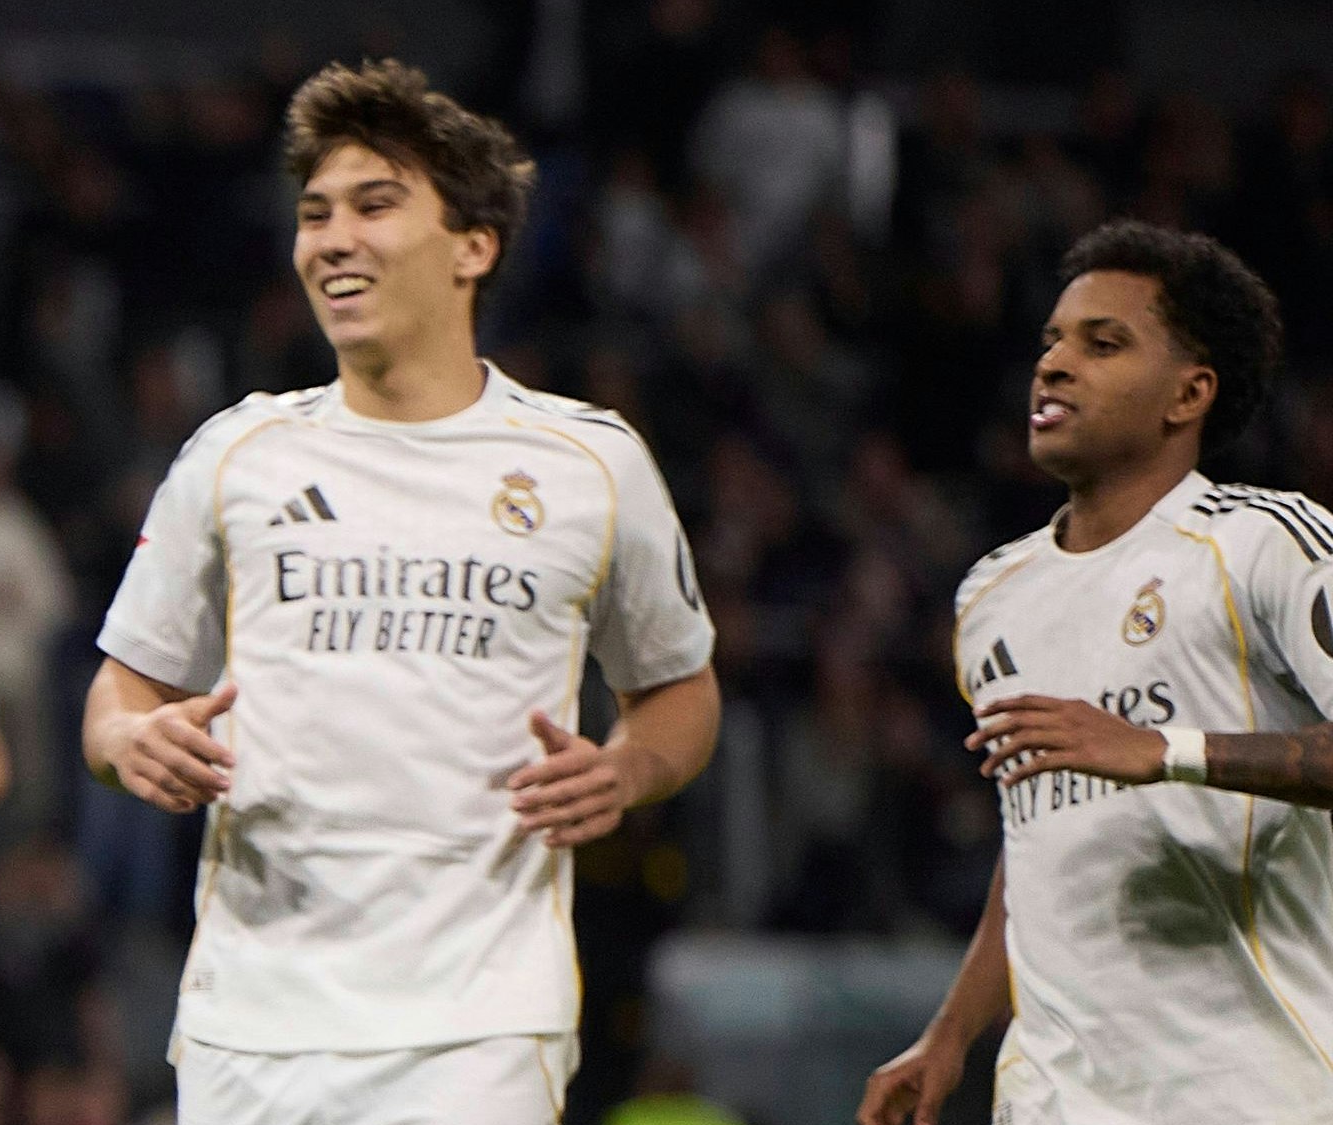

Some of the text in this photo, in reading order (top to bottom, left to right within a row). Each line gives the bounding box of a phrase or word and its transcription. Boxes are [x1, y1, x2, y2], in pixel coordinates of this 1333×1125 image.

[277, 545, 539, 611] Emirates
[307, 610, 495, 659] FLY BETTER
